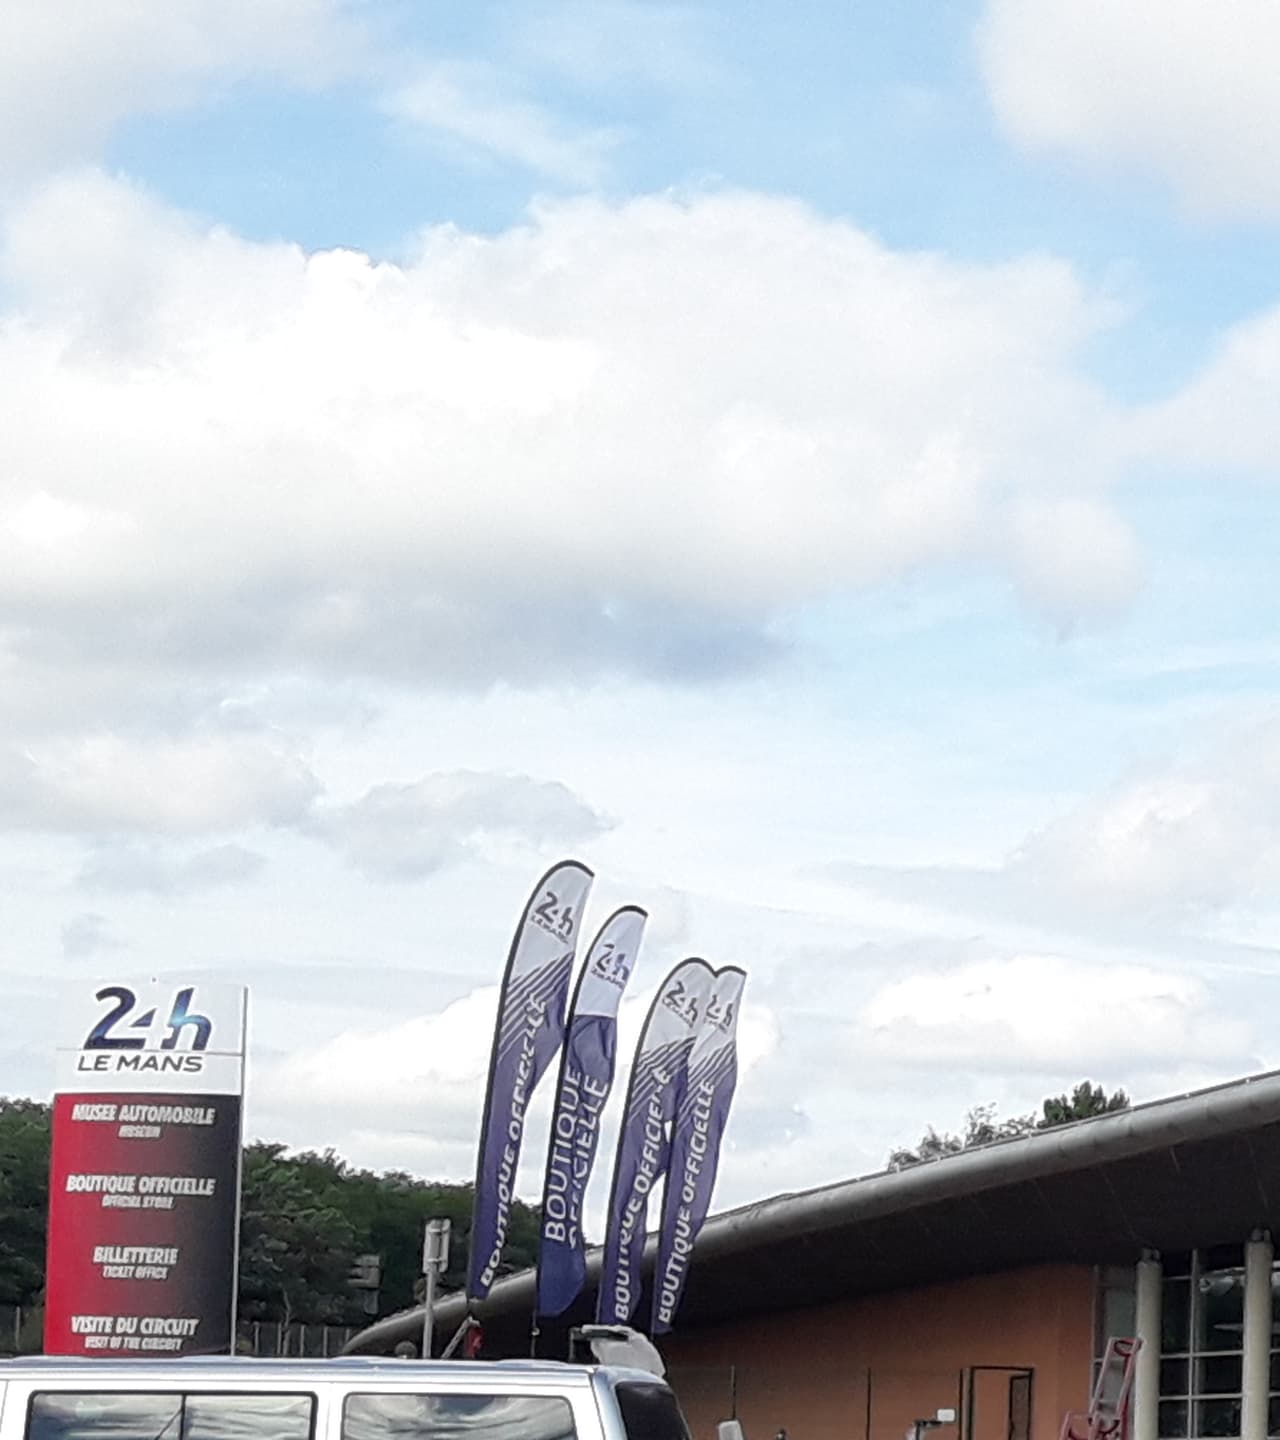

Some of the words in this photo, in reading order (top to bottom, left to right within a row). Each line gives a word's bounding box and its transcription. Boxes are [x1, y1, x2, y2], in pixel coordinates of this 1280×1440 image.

[83, 987, 212, 1050] 24h
[78, 1055, 112, 1071] LE
[116, 1055, 203, 1072] MANS
[118, 1105, 215, 1125] AUTOMOBILE
[545, 1064, 582, 1242] BOUTIQUE
[66, 1175, 136, 1193] BOUTIQUE
[138, 1177, 216, 1195] OFFICIELLE
[658, 1206, 693, 1323] BOUTIQUE
[682, 1080, 714, 1203] OFFICIELLE
[480, 1144, 515, 1287] BOUTIQUE
[93, 1247, 179, 1265] BILLETTERIE
[71, 1316, 113, 1333] VISITE
[116, 1318, 137, 1334] DU
[140, 1319, 199, 1336] CIRCUIT
